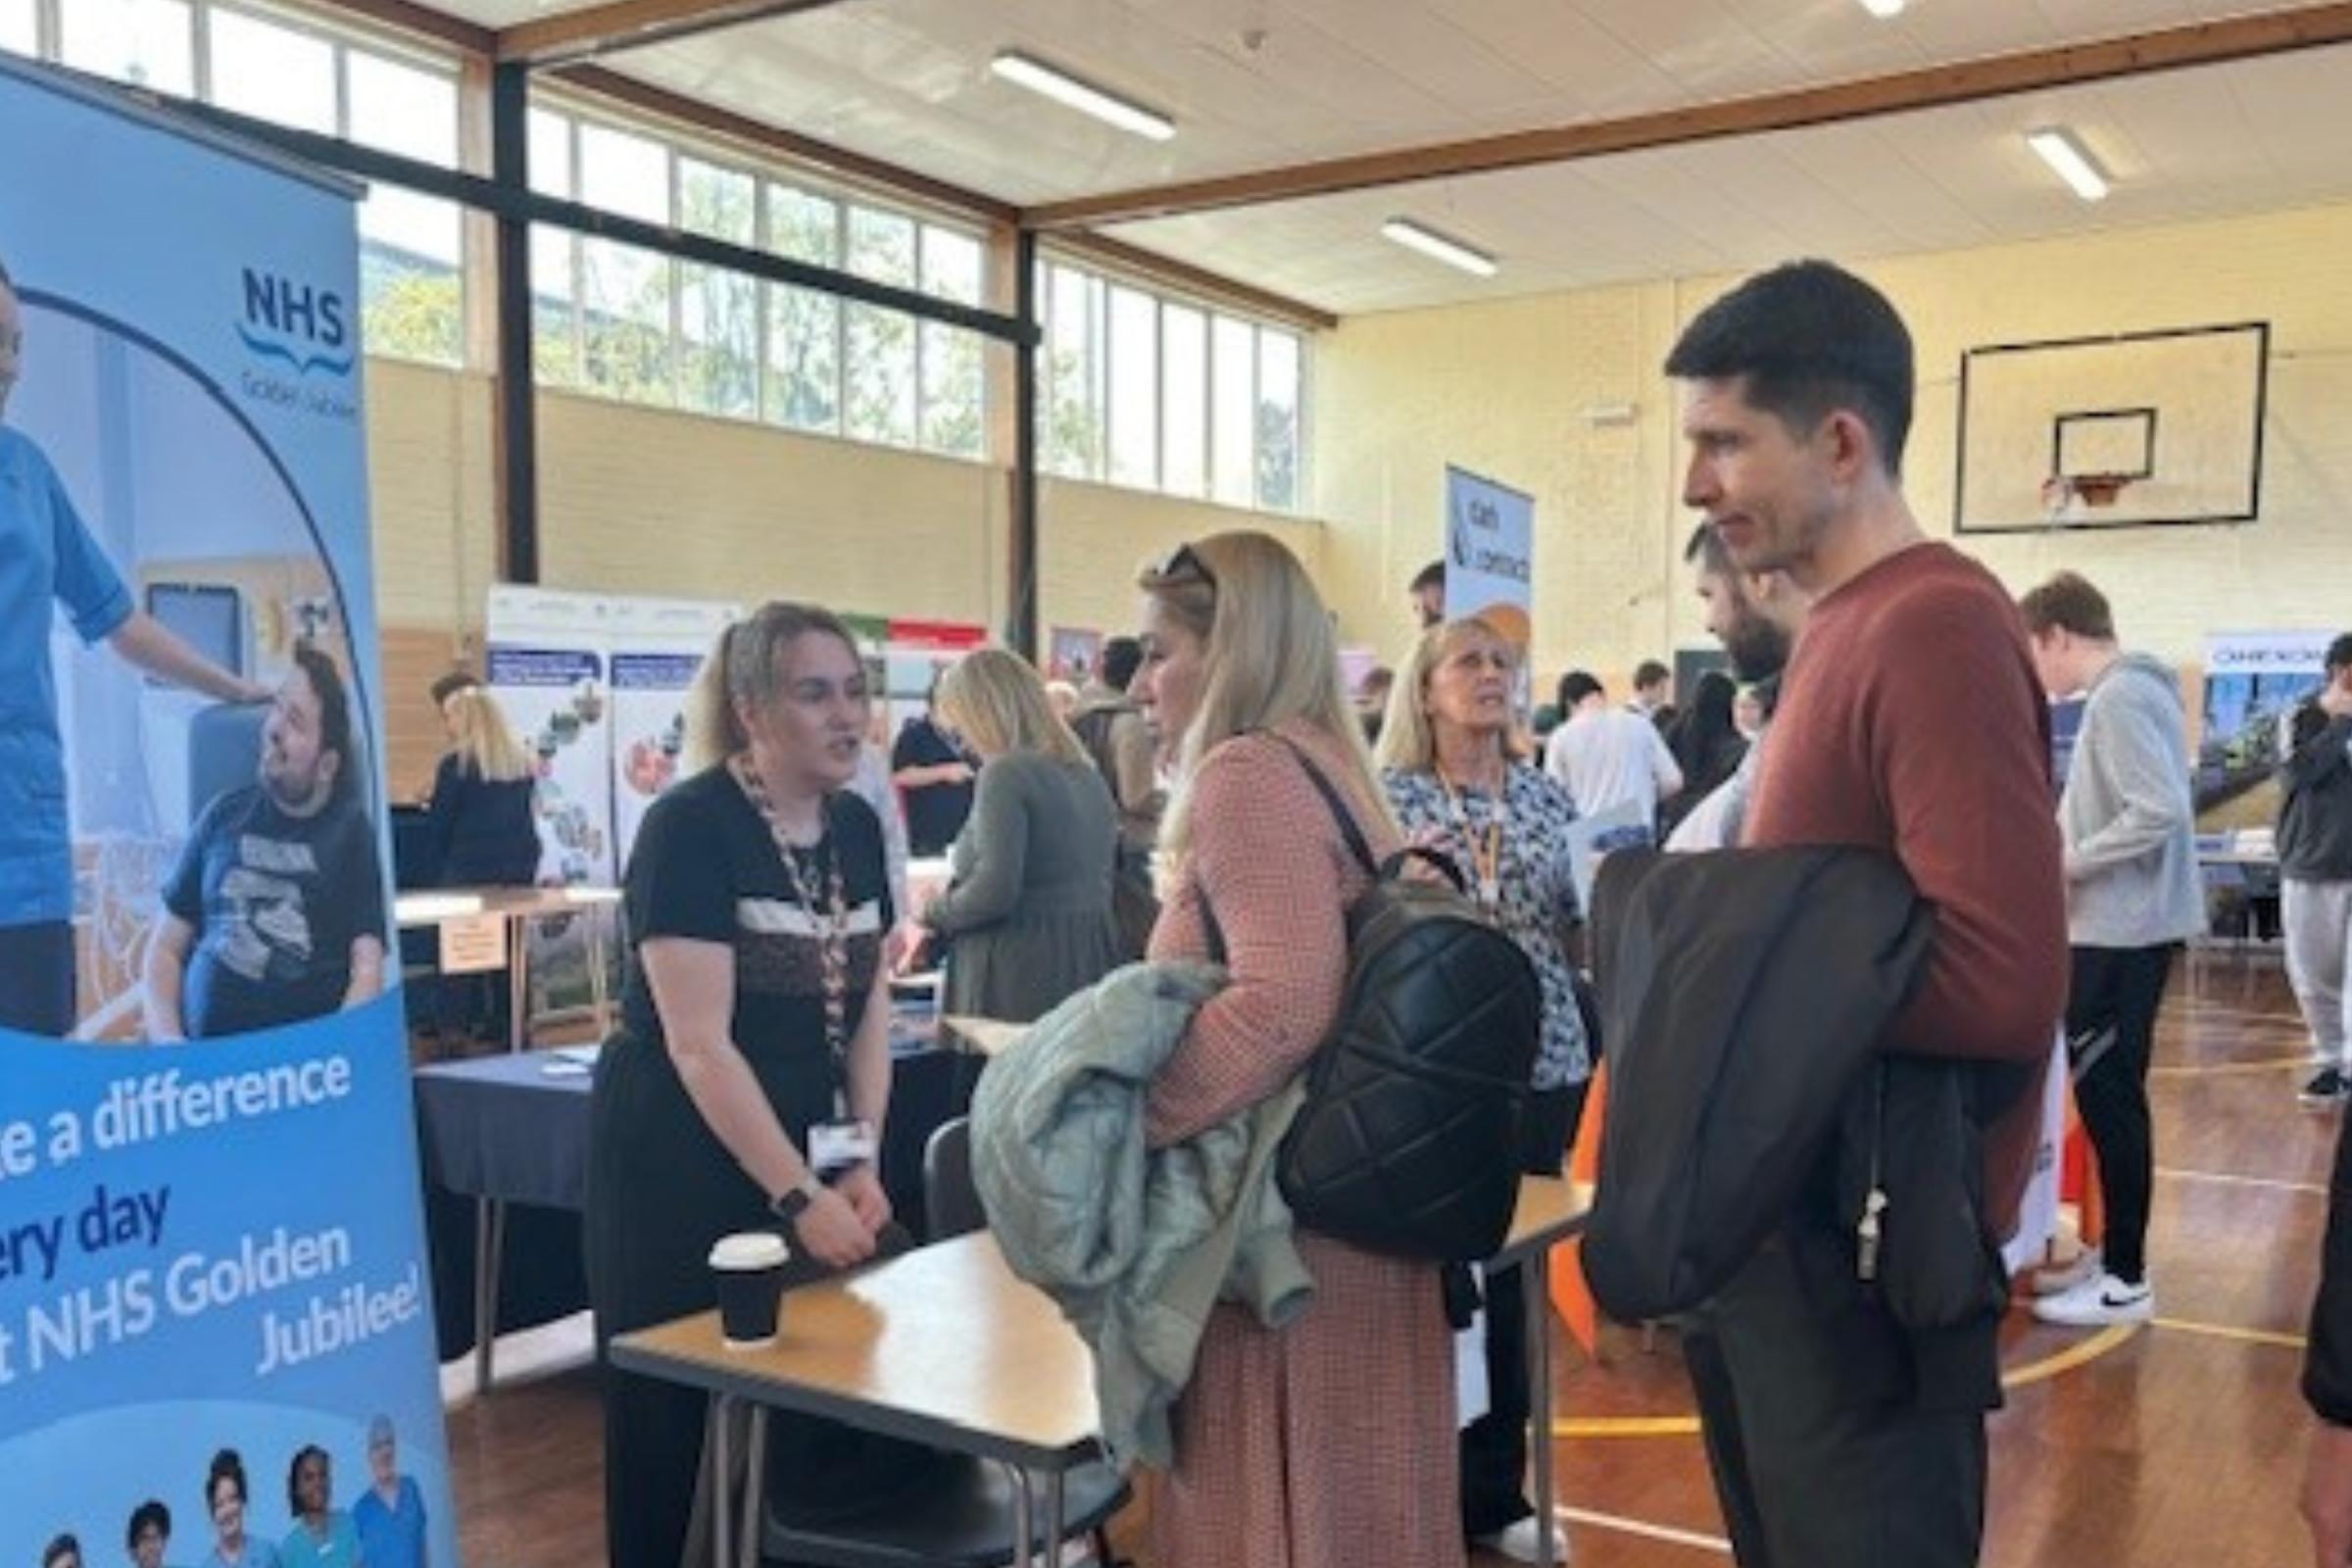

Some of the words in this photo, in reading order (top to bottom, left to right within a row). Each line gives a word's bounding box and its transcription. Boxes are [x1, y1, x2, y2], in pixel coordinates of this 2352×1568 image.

[242, 268, 344, 347] NHS
[0, 1121, 36, 1176] e
[48, 1111, 81, 1165] a
[93, 1054, 351, 1150] difference
[77, 1184, 171, 1248] day
[26, 1269, 155, 1371] NHS
[166, 1227, 351, 1315] Golden
[256, 1259, 421, 1376] Jubilee!
